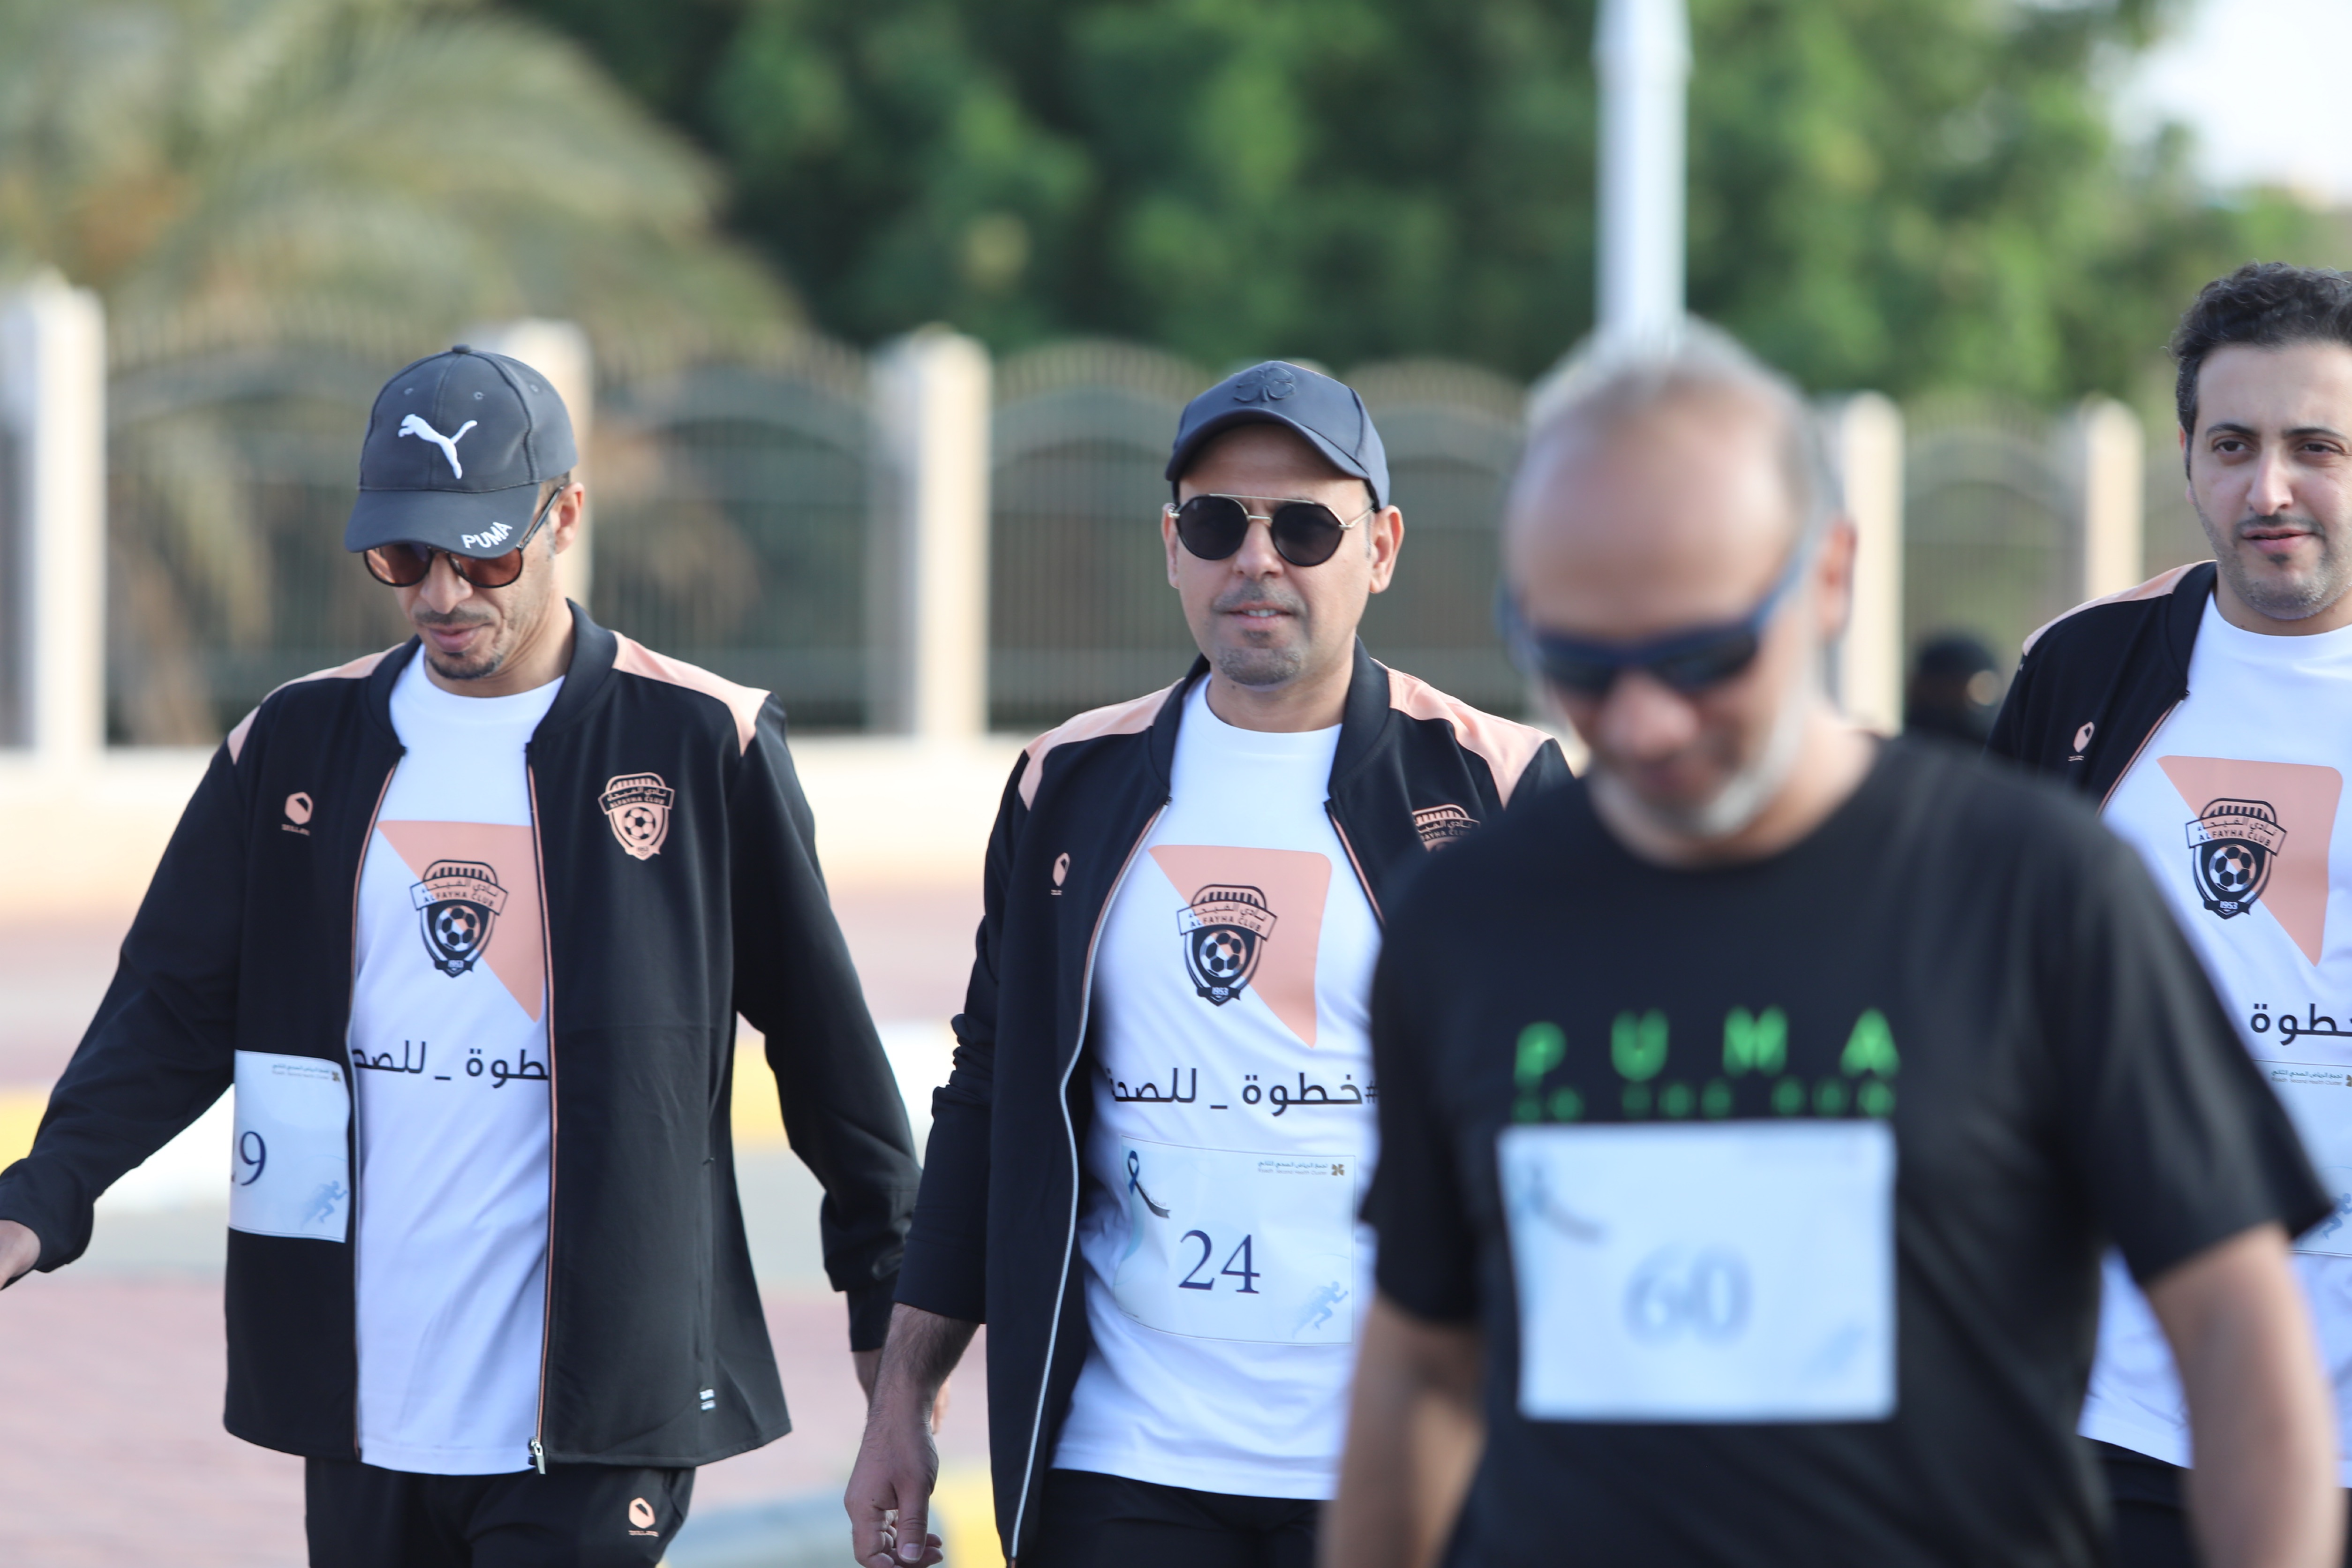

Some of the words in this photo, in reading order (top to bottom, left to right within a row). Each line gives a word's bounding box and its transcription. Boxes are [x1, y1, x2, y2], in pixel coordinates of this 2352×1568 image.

[461, 521, 513, 548] PUMA
[2247, 831, 2271, 846] CLUB
[471, 893, 495, 907] CLUB
[1237, 917, 1261, 932] CLUB
[2251, 1003, 2352, 1046] طوة
[232, 1130, 266, 1186] 9
[1178, 1229, 1260, 1294] 24
[1622, 1245, 1753, 1348] 60
